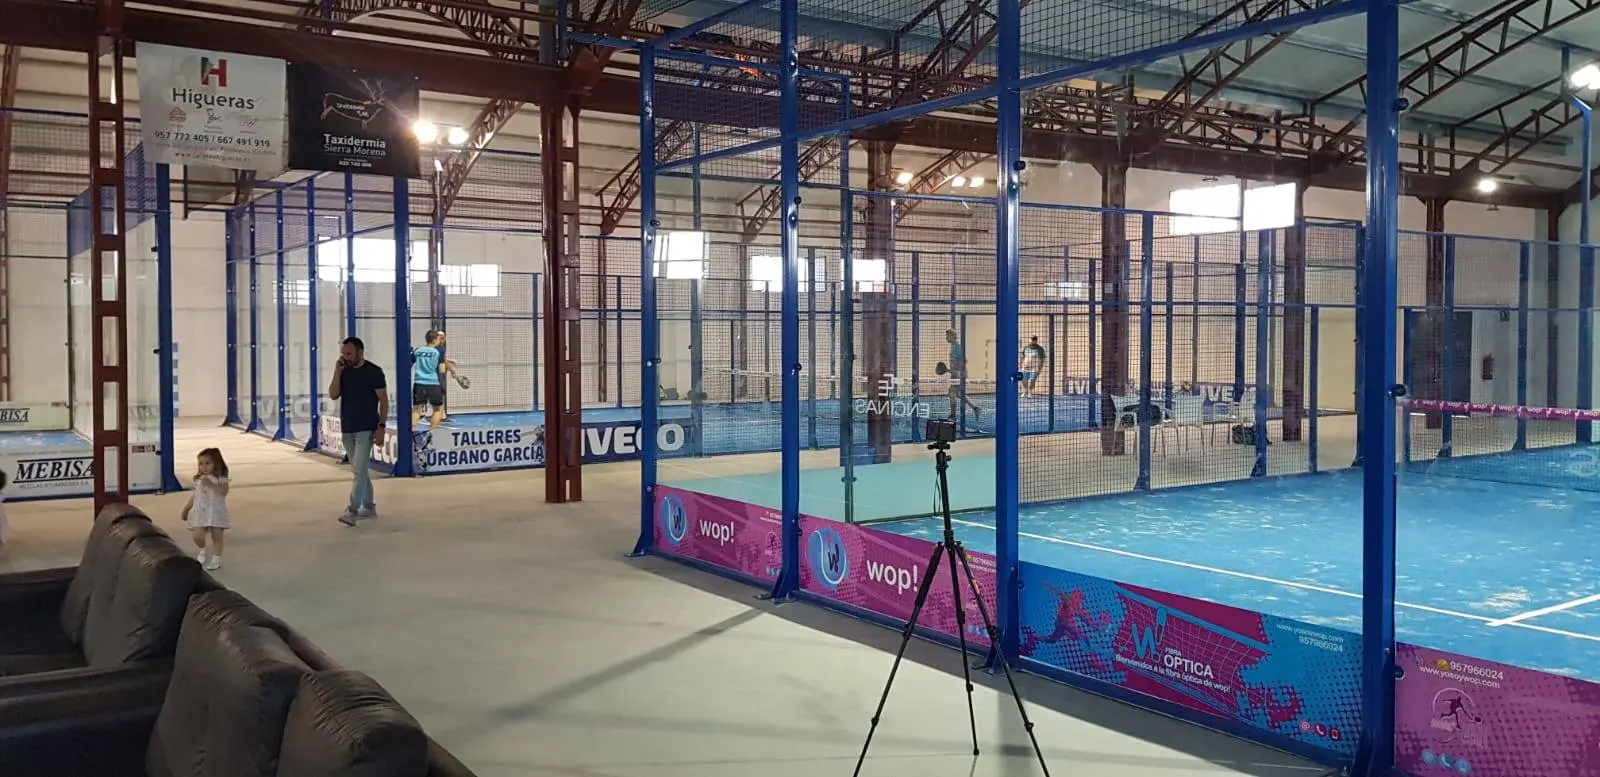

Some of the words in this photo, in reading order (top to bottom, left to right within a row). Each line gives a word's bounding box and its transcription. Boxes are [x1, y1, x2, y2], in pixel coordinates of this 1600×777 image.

[172, 87, 255, 109] Higueras
[154, 130, 171, 139] 957
[175, 132, 190, 140] 772
[193, 134, 209, 142] 405
[217, 136, 233, 144] 667
[236, 138, 251, 146] 491
[255, 139, 271, 147] 919
[323, 134, 386, 148] Taxidermia
[324, 144, 351, 153] Sierra
[353, 147, 386, 156] Morena
[451, 429, 521, 447] TALLERES
[427, 447, 489, 467] URBANO
[494, 442, 544, 462] GARCÍA
[700, 519, 735, 546] wop!
[866, 560, 918, 595] wop!
[1165, 648, 1182, 657] FIBRA
[1116, 654, 1152, 671] Bienvenidos
[1166, 668, 1181, 679] fibra
[1203, 678, 1213, 688] de
[1213, 683, 1231, 693] wop!
[1163, 654, 1213, 679] OPTICA
[1419, 665, 1500, 688] www.yosoywop.com
[1450, 660, 1504, 681] 957966024
